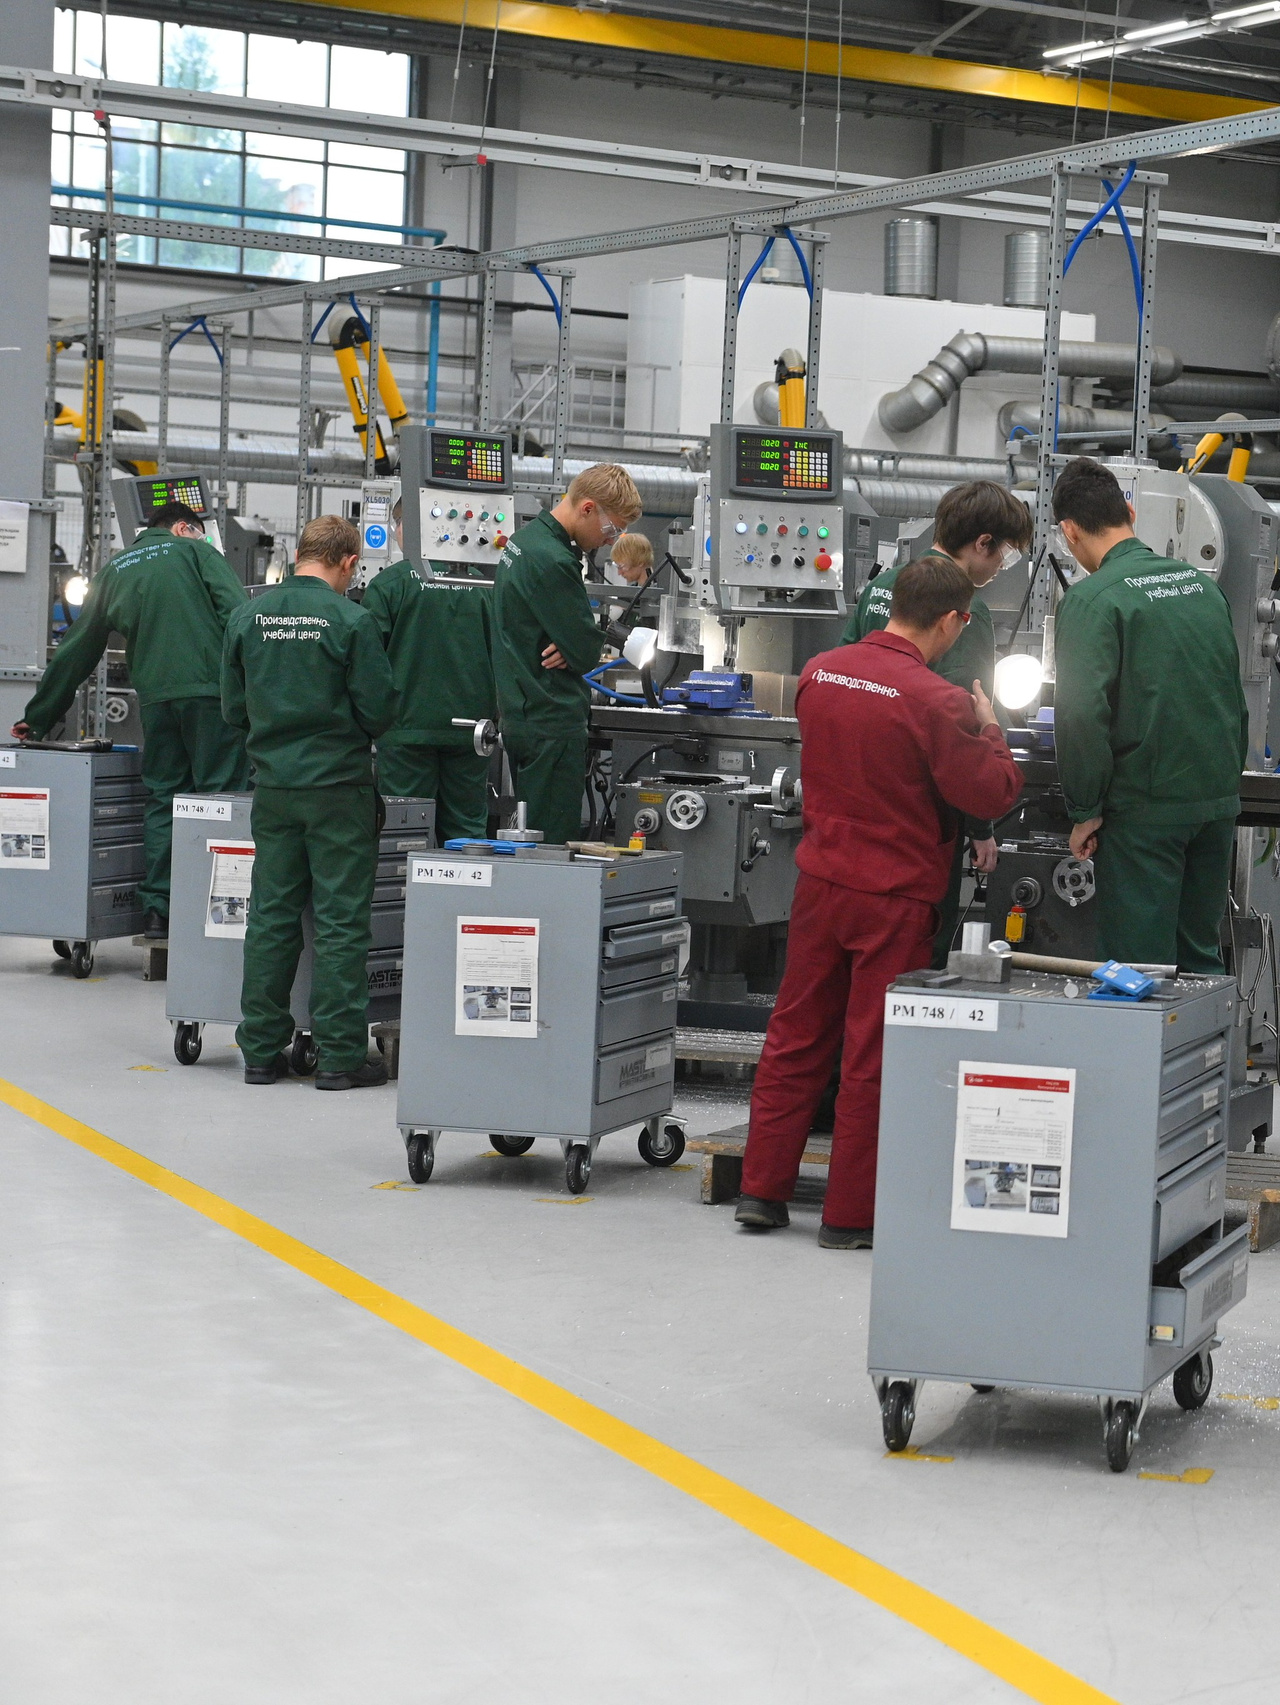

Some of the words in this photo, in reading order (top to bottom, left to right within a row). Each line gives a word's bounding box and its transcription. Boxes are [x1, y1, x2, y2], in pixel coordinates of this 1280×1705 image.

[1123, 569, 1197, 588] Производственно-
[1145, 584, 1180, 602] учебный
[1180, 582, 1204, 596] центр
[812, 668, 901, 698] Производственно-
[1, 756, 10, 764] 42
[191, 804, 205, 813] 748
[216, 806, 226, 815] 42
[438, 868, 455, 879] 748
[471, 871, 482, 880] 42
[921, 1006, 945, 1019] 748
[968, 1008, 985, 1022] 42
